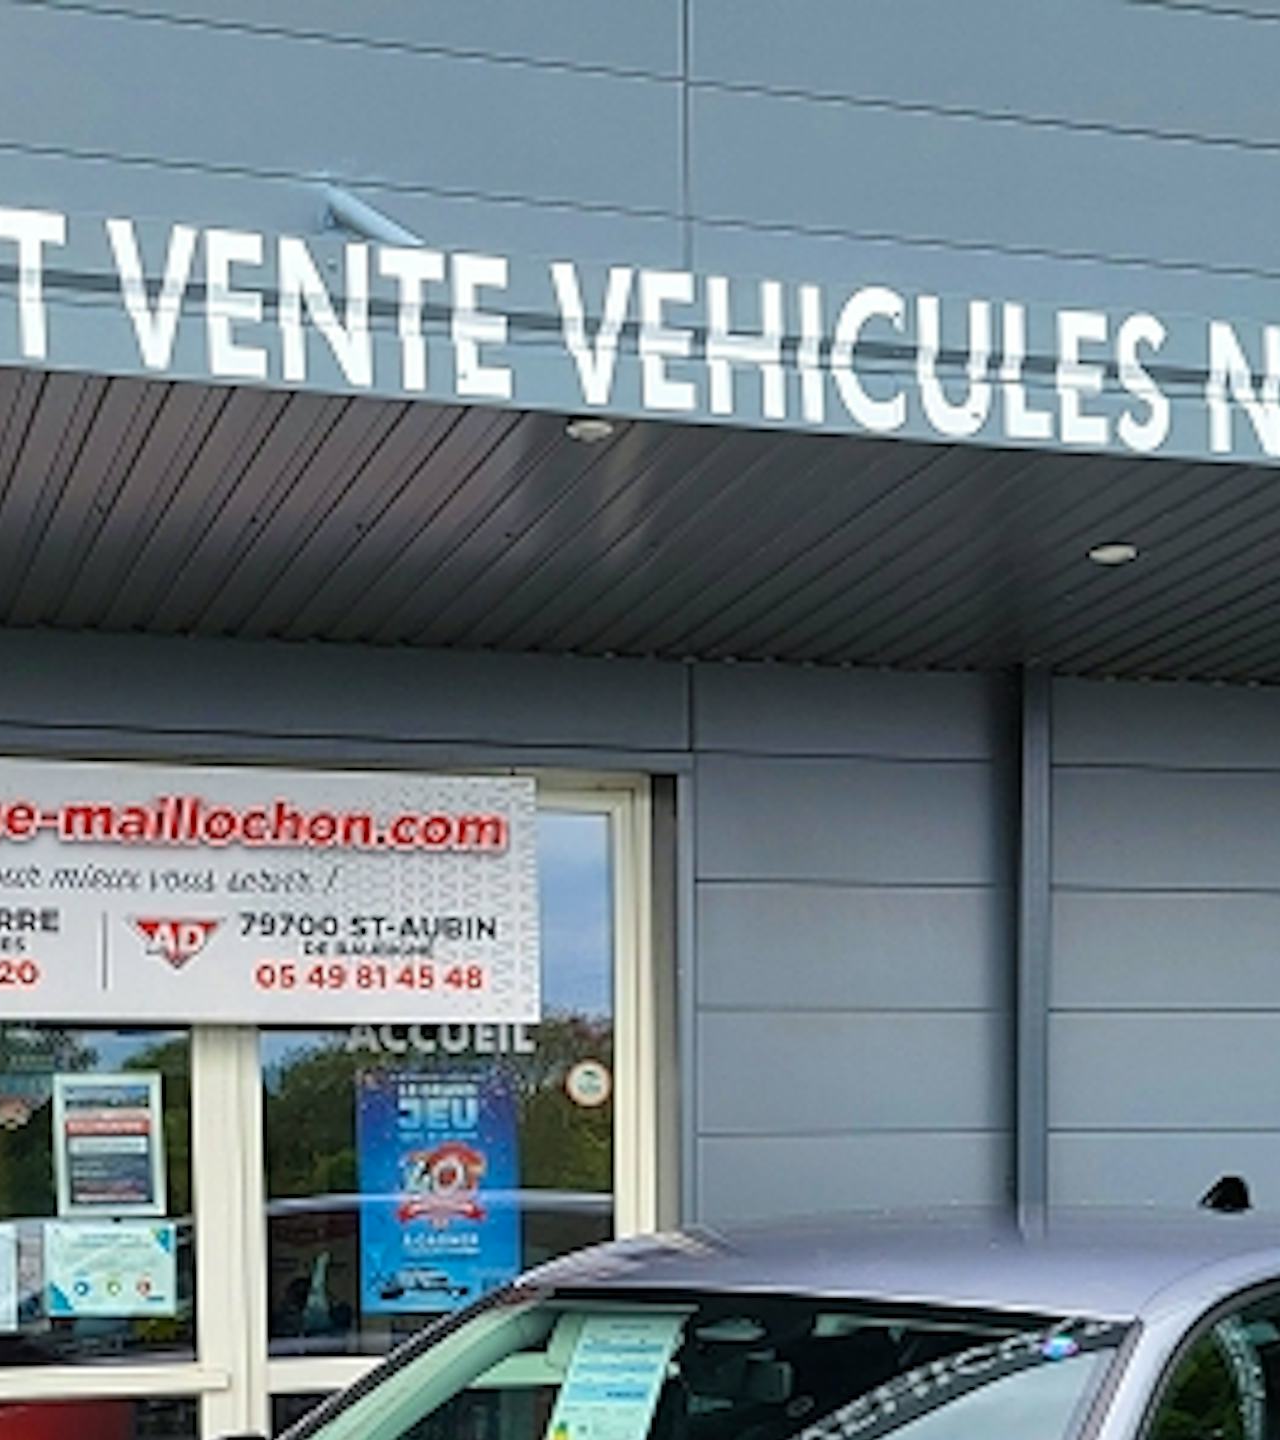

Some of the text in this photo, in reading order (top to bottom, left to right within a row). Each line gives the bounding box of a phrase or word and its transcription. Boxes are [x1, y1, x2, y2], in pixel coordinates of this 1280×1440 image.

[106, 218, 513, 400] VENTE
[551, 263, 1169, 452] VEHICULES
[148, 923, 204, 952] AD
[238, 913, 496, 940] 79700 ST-AUBIN
[256, 965, 482, 989] 05 49 81 45 48
[346, 1024, 537, 1055] ACCUEIL
